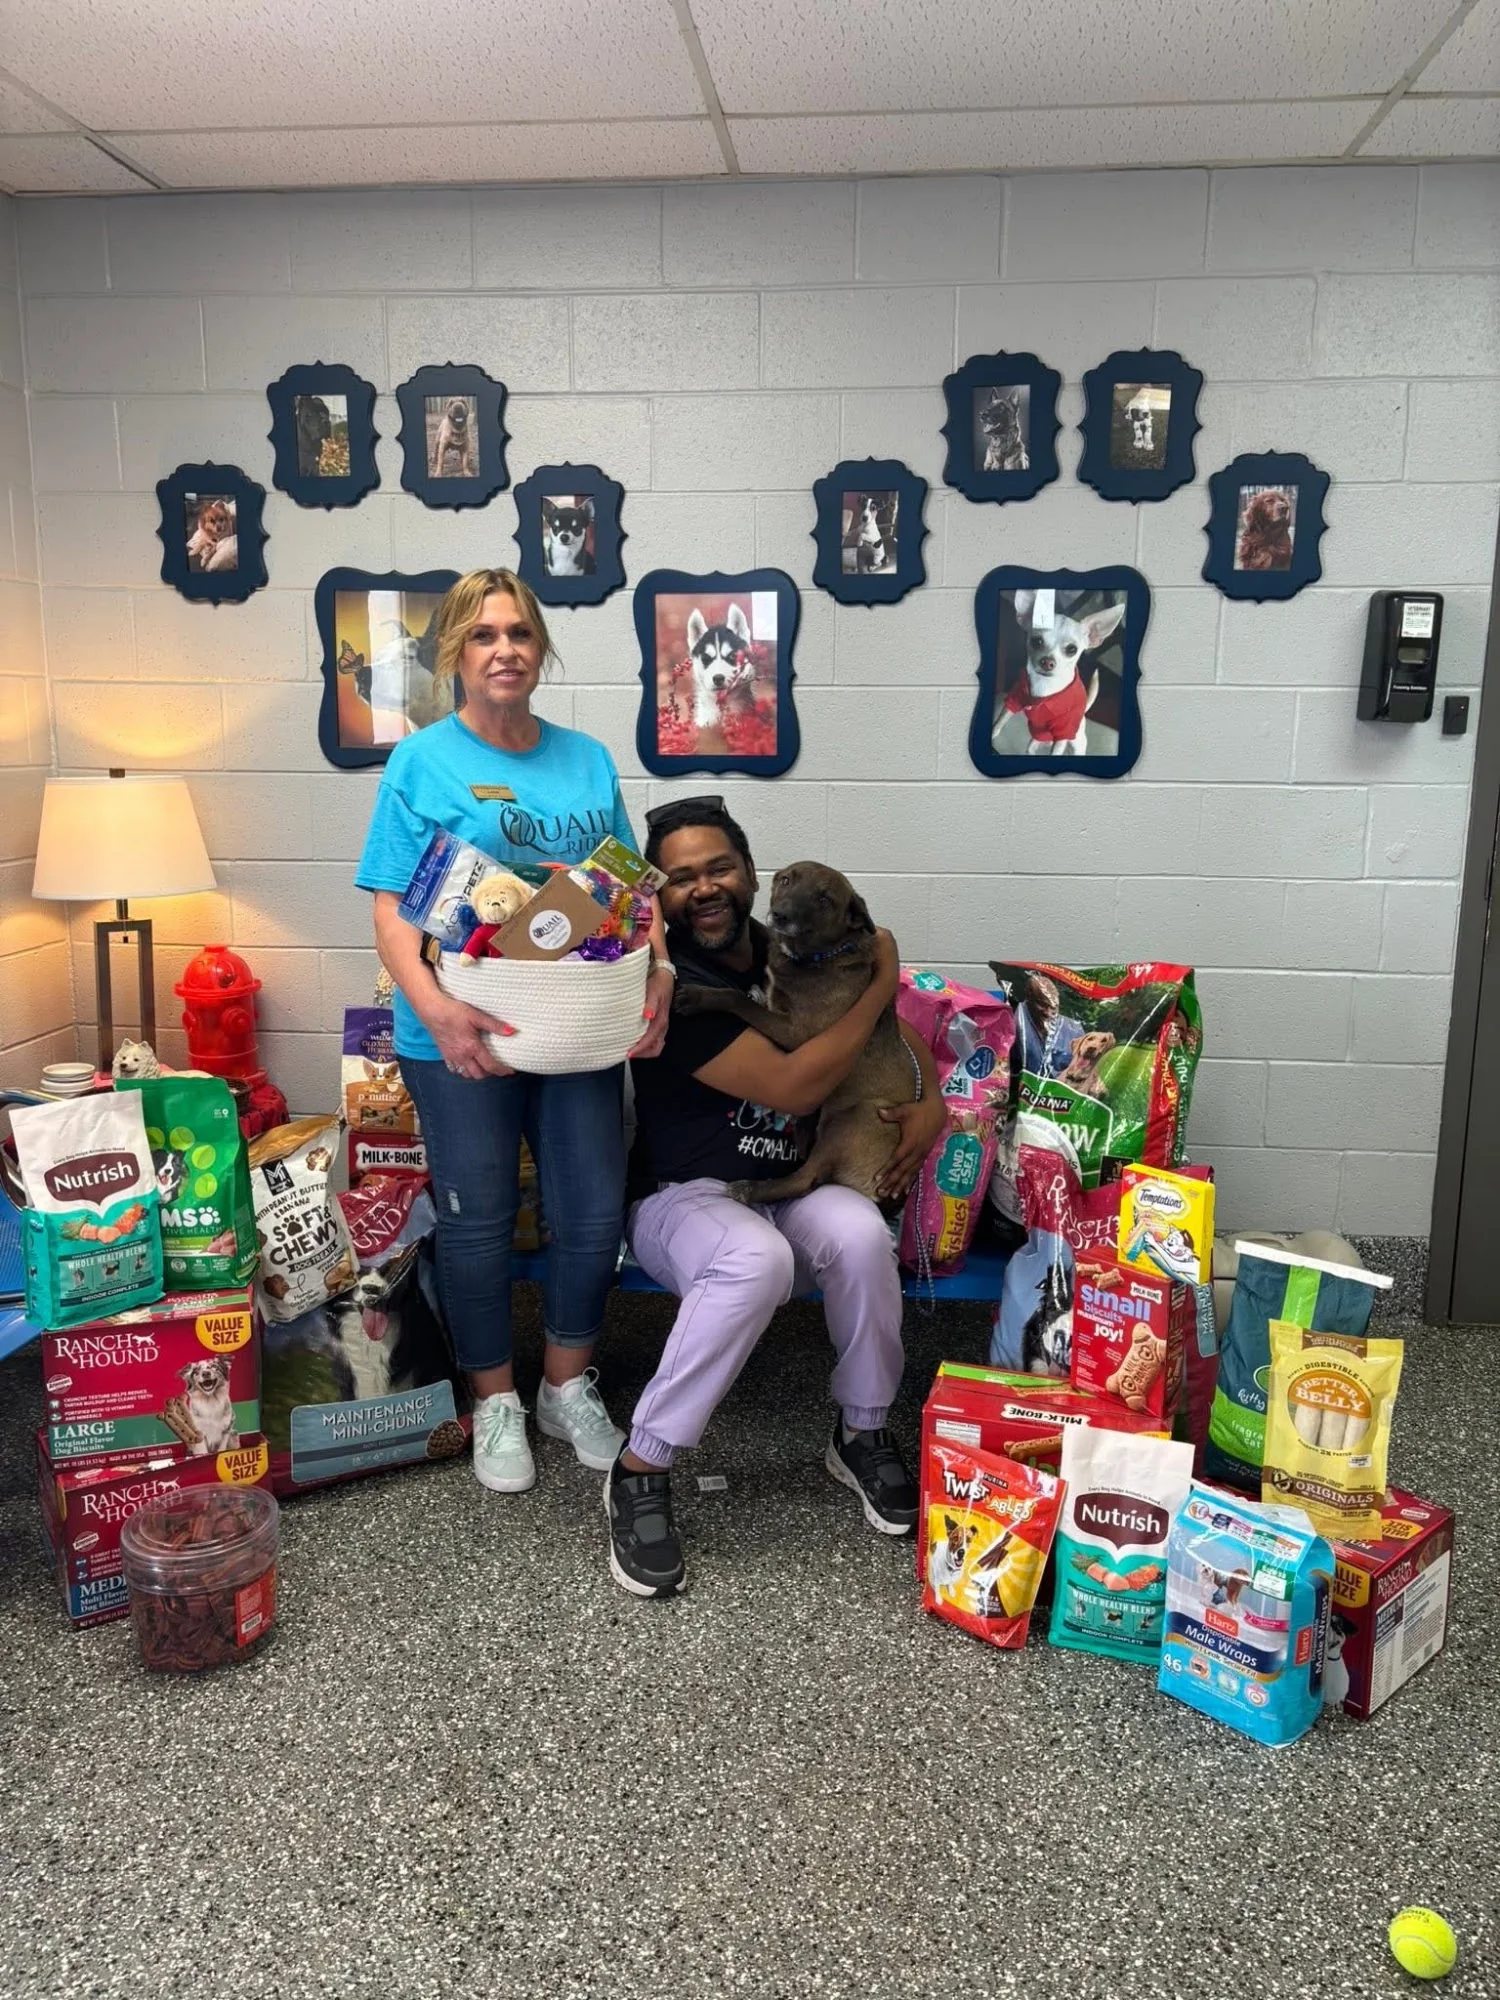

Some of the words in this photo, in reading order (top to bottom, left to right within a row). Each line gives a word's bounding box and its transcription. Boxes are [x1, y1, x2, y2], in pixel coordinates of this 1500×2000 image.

[500, 803, 611, 856] QUAIL
[567, 836, 601, 854] RID
[533, 914, 563, 939] QUAIL
[1066, 972, 1096, 990] SMART
[946, 1077, 963, 1094] 32
[1021, 1087, 1069, 1110] PURINA
[948, 1148, 964, 1184] LAND
[960, 1152, 975, 1178] SEA
[54, 1162, 133, 1192] Nutrish
[270, 1190, 297, 1210] PEANUT
[279, 1196, 310, 1214] BANANA
[1140, 1189, 1183, 1209] Temptations
[324, 1206, 332, 1219] &
[187, 1226, 223, 1234] HEALTH
[270, 1219, 338, 1265] CHEWY
[68, 1257, 94, 1269] WHOLE
[97, 1251, 124, 1263] HEALTH
[125, 1244, 147, 1257] BLEND
[294, 1258, 312, 1270] DOG
[312, 1244, 336, 1264] TREATS
[82, 1291, 107, 1302] INDOOR
[107, 1283, 139, 1295] COMPLETE
[1080, 1284, 1152, 1321] small
[204, 1316, 245, 1332] VALUE
[1076, 1309, 1115, 1327] maximum
[1084, 1303, 1126, 1326] biscuits,
[212, 1331, 240, 1345] SIZE
[1094, 1323, 1124, 1343] joy!
[55, 1333, 133, 1363] RANCH
[79, 1347, 159, 1369] HOUND
[1124, 1355, 1140, 1372] MILK
[1304, 1361, 1360, 1380] DIGESTIBLE
[1303, 1377, 1359, 1399] BETTER
[1295, 1386, 1366, 1412] BELLY
[322, 1394, 433, 1427] MAINTENANCE
[1009, 1407, 1082, 1425] MILK-BONE
[53, 1420, 116, 1440] LARGE
[332, 1411, 427, 1440] MINI-CHUNK
[1231, 1420, 1264, 1441] fragra
[54, 1438, 88, 1449] Original
[90, 1436, 115, 1444] Flavor
[55, 1447, 72, 1455] Dog
[73, 1444, 105, 1453] Biscuits
[1244, 1437, 1262, 1448] cat
[224, 1449, 262, 1469] VALUE
[232, 1464, 259, 1481] SIZE
[984, 1473, 1009, 1489] PURINA
[82, 1480, 158, 1517] RANCH
[1111, 1487, 1125, 1495] Helps
[1147, 1495, 1161, 1505] Need
[1296, 1481, 1374, 1504] ORIGINALS
[1081, 1502, 1161, 1534] Nutrish
[1386, 1519, 1414, 1531] SIZE
[79, 1575, 127, 1598] MEDI
[1377, 1562, 1408, 1594] RANCH
[1384, 1569, 1413, 1600] HOUND
[80, 1595, 102, 1606] Multi
[1072, 1588, 1098, 1605] WHOLE
[1099, 1599, 1129, 1613] HEALTH
[1130, 1605, 1157, 1615] BLEND
[1333, 1581, 1356, 1602] IZE
[81, 1604, 98, 1613] Dog
[1317, 1594, 1329, 1639] Wraps
[1208, 1613, 1235, 1632] Hartz
[1081, 1628, 1108, 1638] INDOOR
[1108, 1634, 1144, 1645] COMPLETE
[1201, 1624, 1241, 1647] Disposable
[1298, 1629, 1310, 1662] Hartz
[1185, 1625, 1215, 1647] Male
[1217, 1640, 1258, 1667] Wraps
[1163, 1653, 1182, 1673] 46
[1223, 1657, 1248, 1673] Secure
[1315, 1640, 1324, 1675] Male
